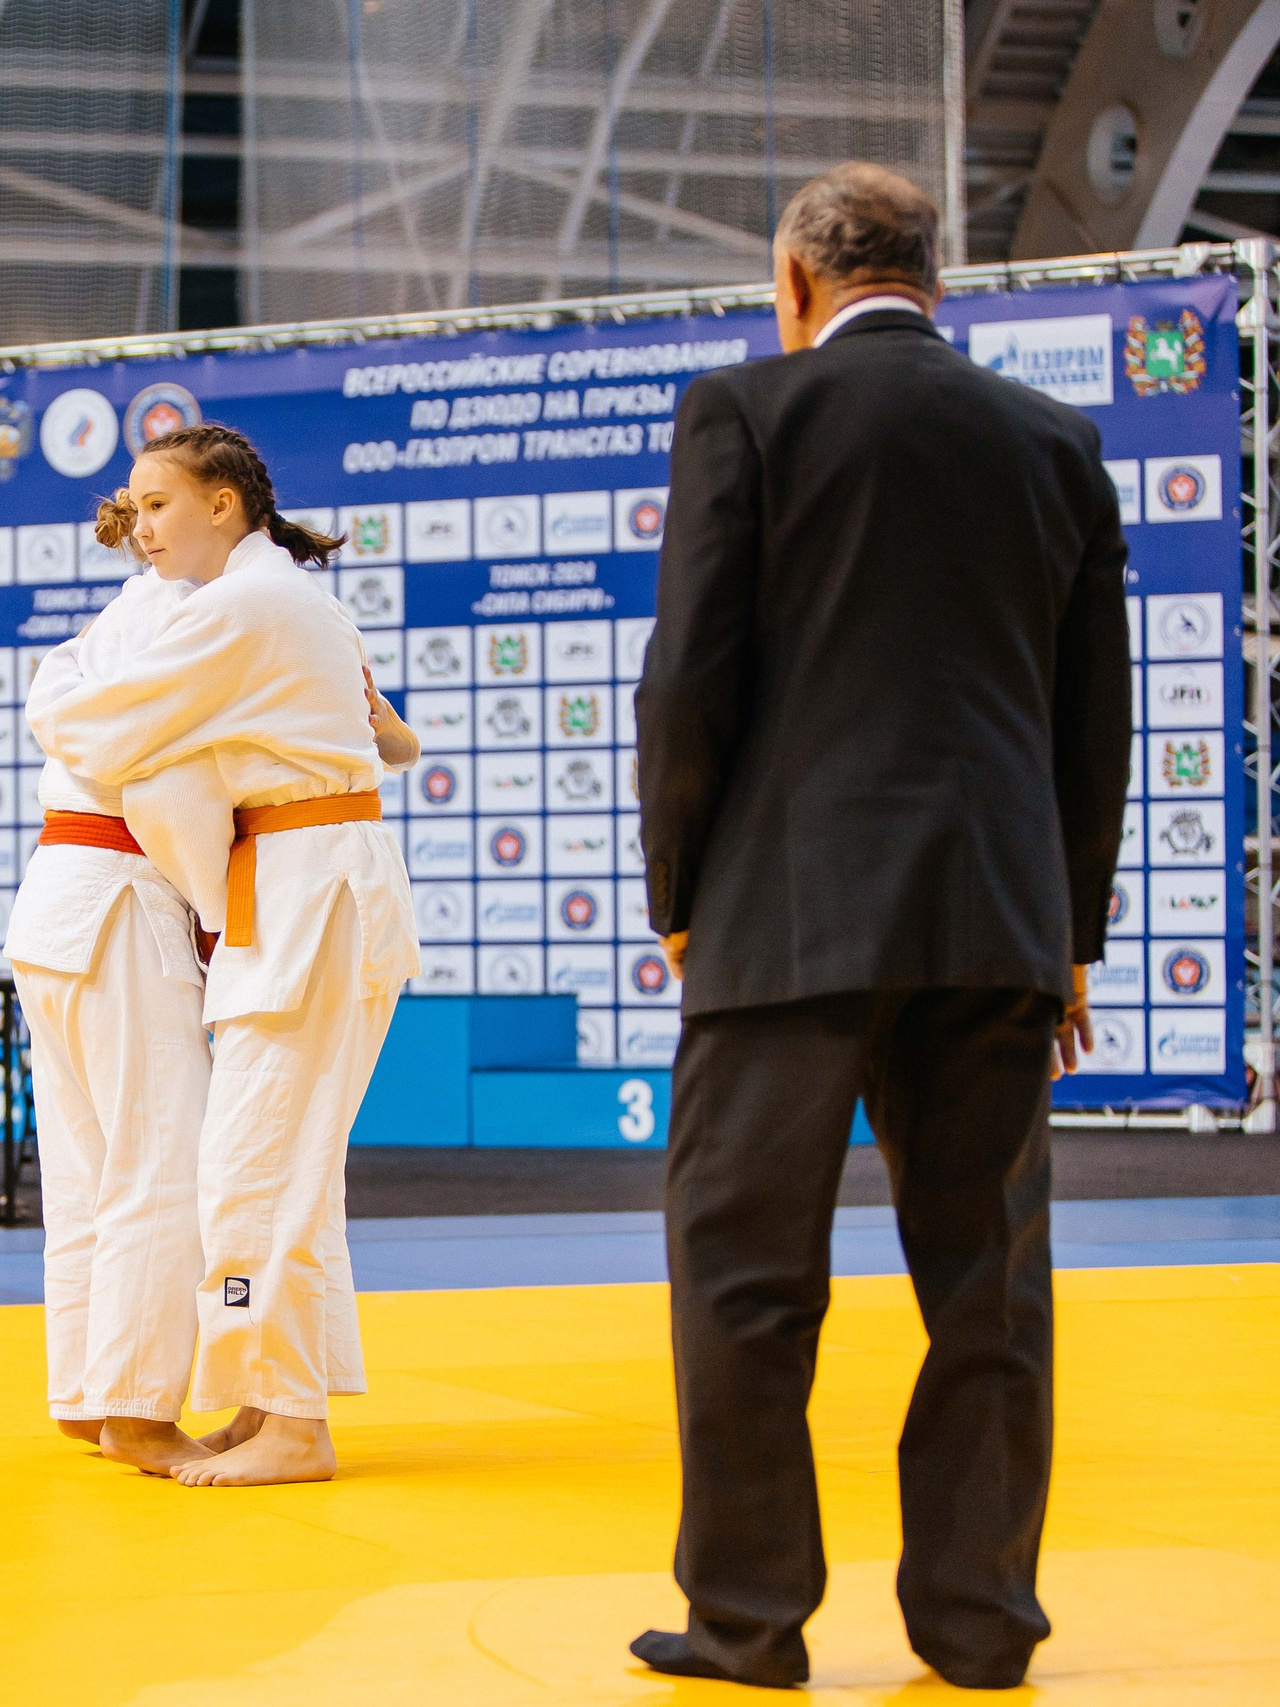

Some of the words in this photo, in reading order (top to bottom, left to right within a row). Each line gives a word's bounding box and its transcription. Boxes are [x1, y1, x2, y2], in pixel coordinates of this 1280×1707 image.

[343, 352, 547, 398] ВСЕРОССИЙСКИЕ
[548, 338, 748, 383] СОРЕВНОВАНИЯ
[410, 398, 450, 431] ПО
[447, 391, 542, 431] ДЗЮДО
[543, 390, 580, 421] НА
[582, 382, 677, 418] ПРИЗЫ
[523, 424, 644, 461] ТРАНСГАЗ
[618, 1078, 655, 1143] 3
